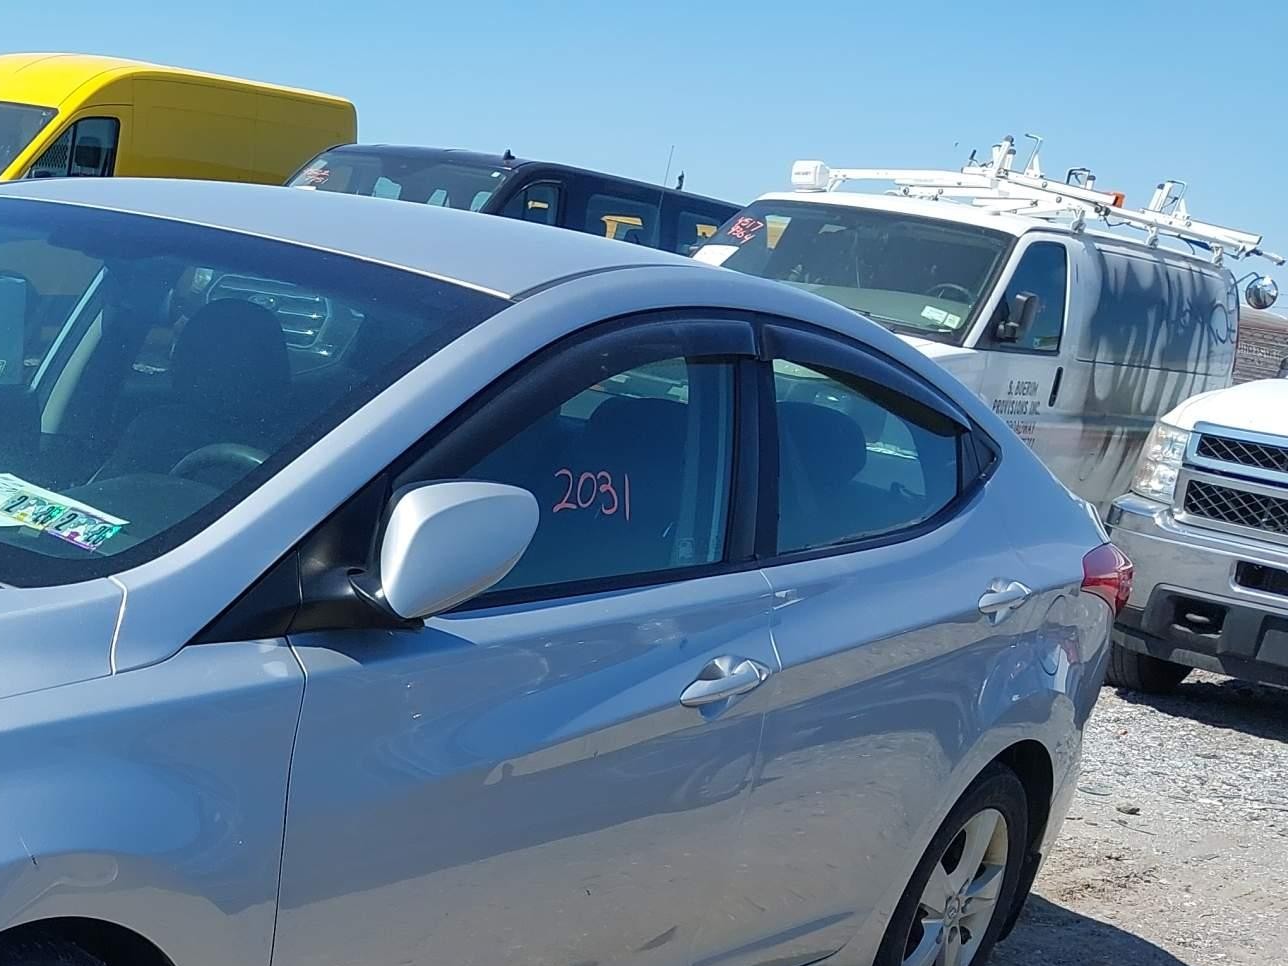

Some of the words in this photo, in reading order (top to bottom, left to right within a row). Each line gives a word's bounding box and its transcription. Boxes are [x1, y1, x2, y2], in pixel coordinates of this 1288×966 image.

[992, 399, 1029, 415] PROVISIONS
[4, 495, 29, 513] 2
[552, 468, 630, 521] 2031
[54, 512, 78, 532] 2
